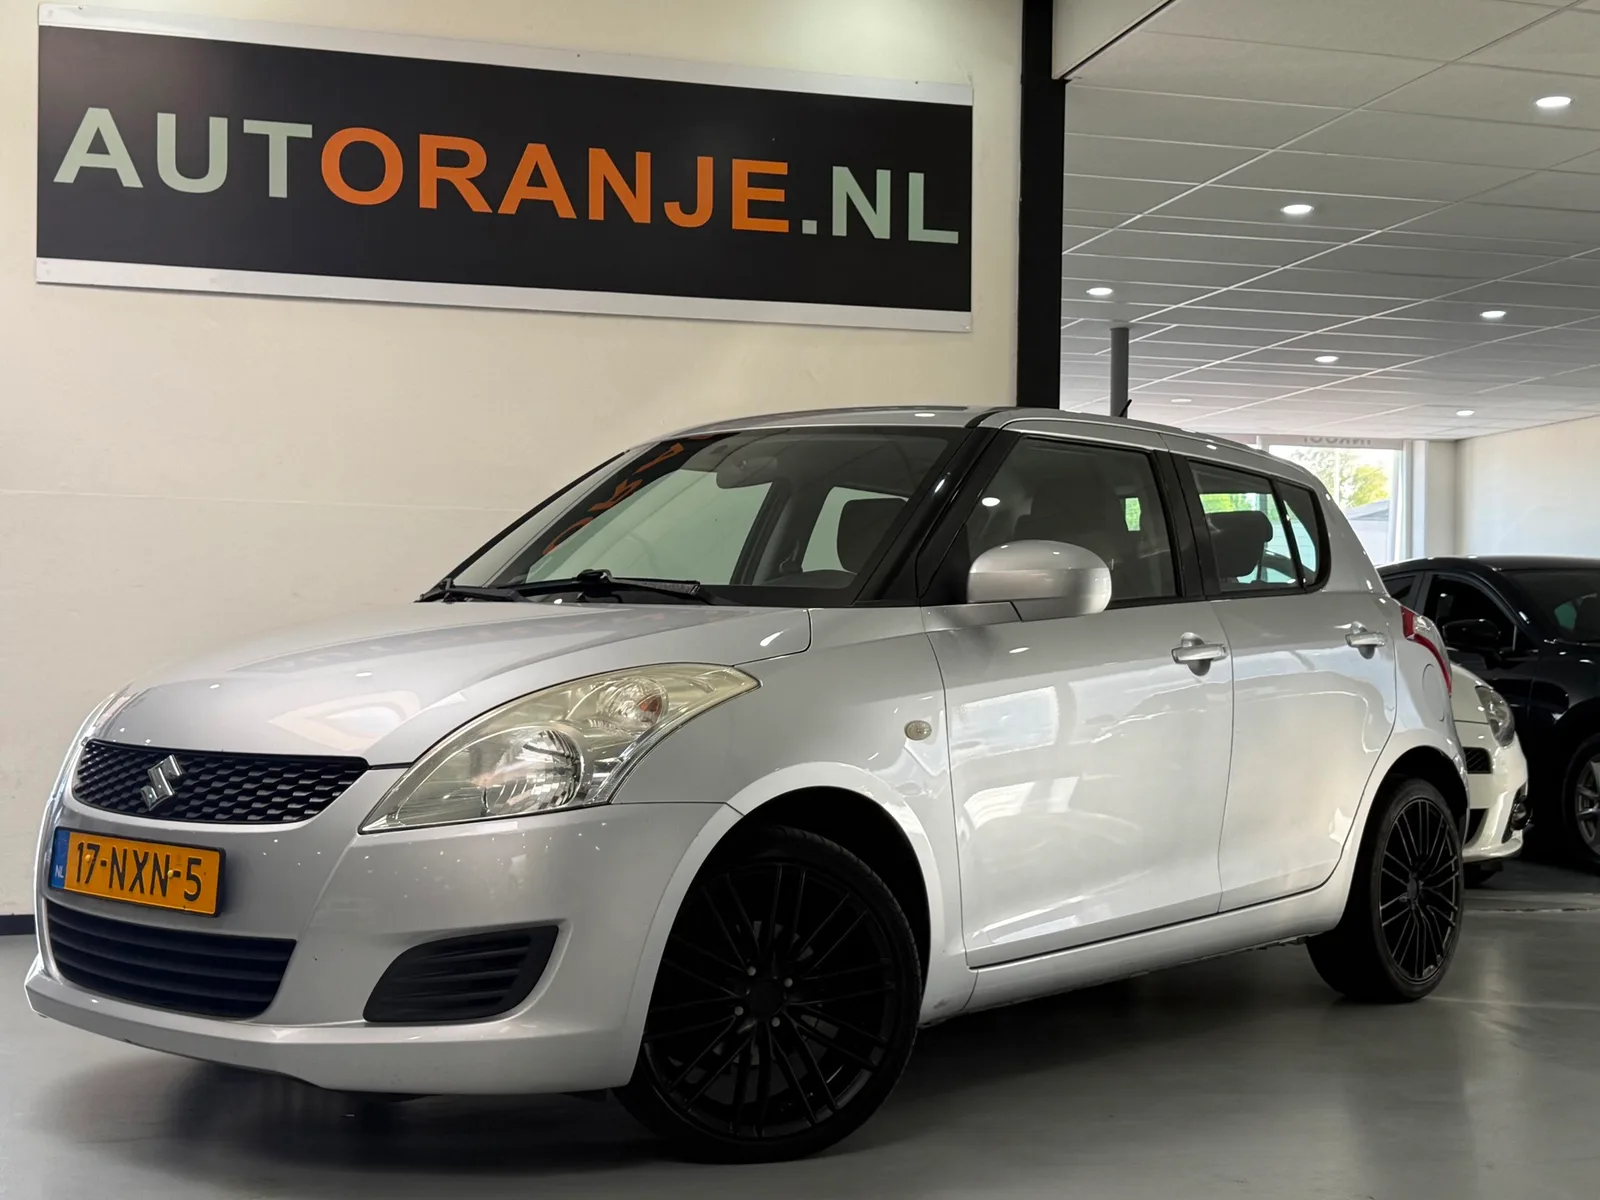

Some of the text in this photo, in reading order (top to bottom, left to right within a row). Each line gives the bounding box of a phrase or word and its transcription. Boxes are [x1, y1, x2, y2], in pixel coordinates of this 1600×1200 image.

[53, 107, 959, 244] AUTORANJE.NL
[55, 865, 64, 878] NL
[77, 842, 202, 901] 17-NXN-5
